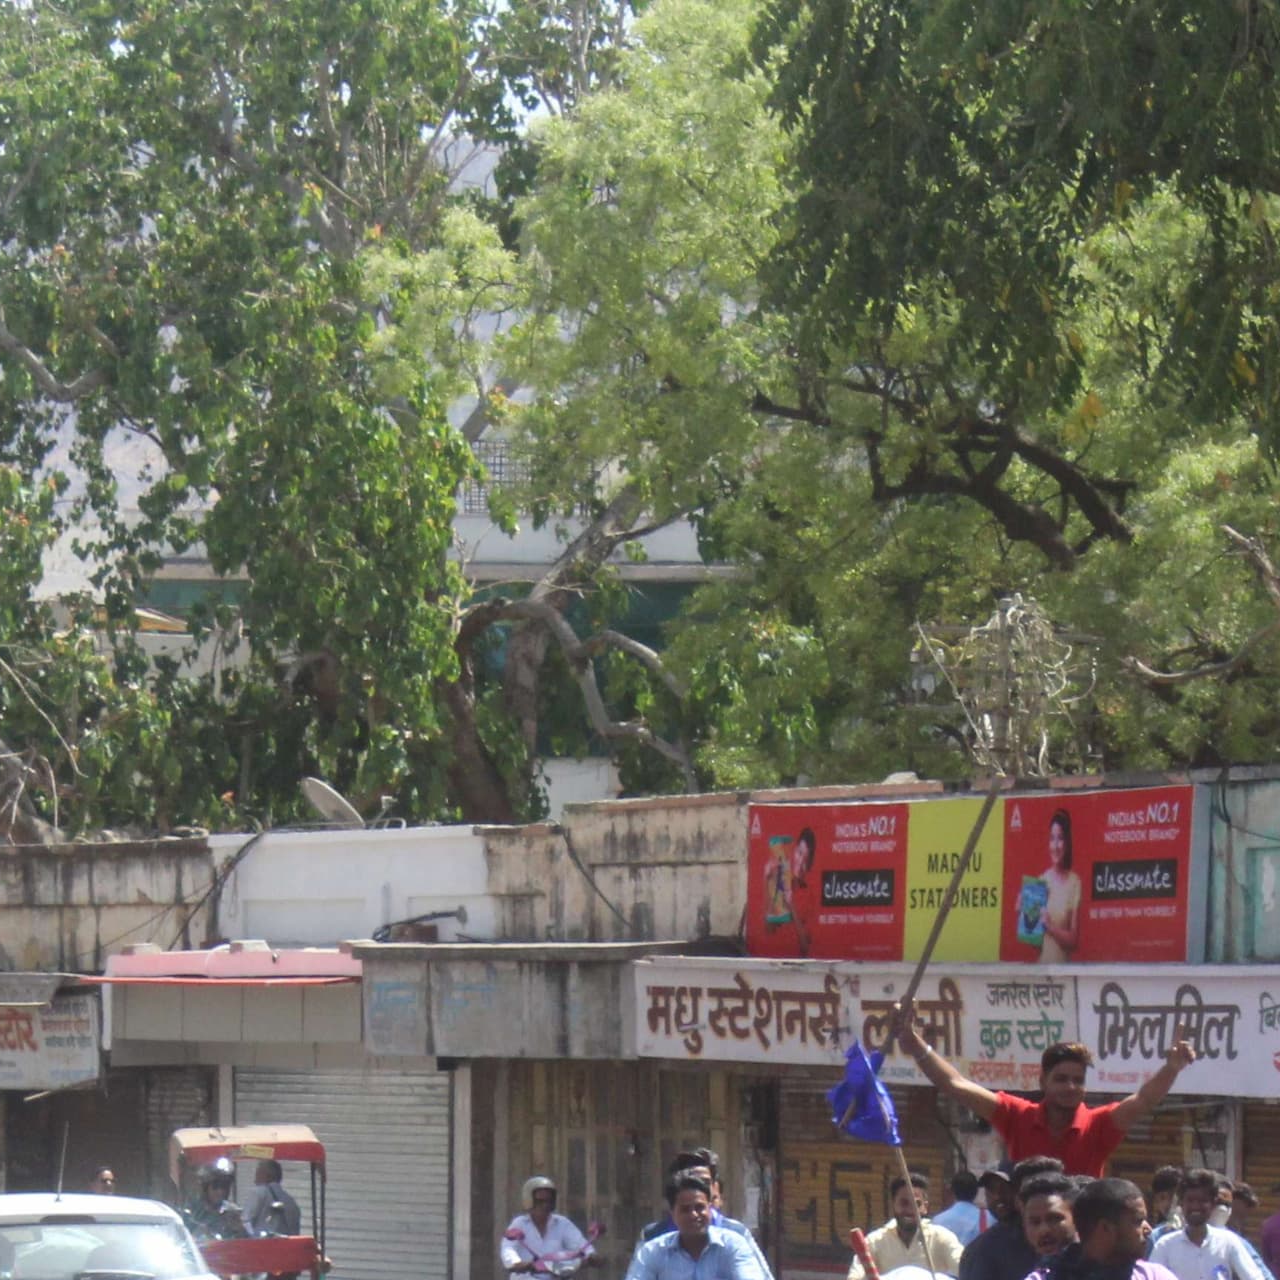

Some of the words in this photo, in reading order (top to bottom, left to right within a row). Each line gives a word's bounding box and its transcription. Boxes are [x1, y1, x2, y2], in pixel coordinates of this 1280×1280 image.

[868, 815, 896, 837] NO.1
[1146, 802, 1179, 824] NO.1
[909, 886, 999, 910] STATONERS
[985, 980, 1033, 1009] जनरल
[1032, 976, 1067, 1010] स्टोर
[646, 984, 704, 1055] मधु
[979, 1018, 1012, 1059] बुक
